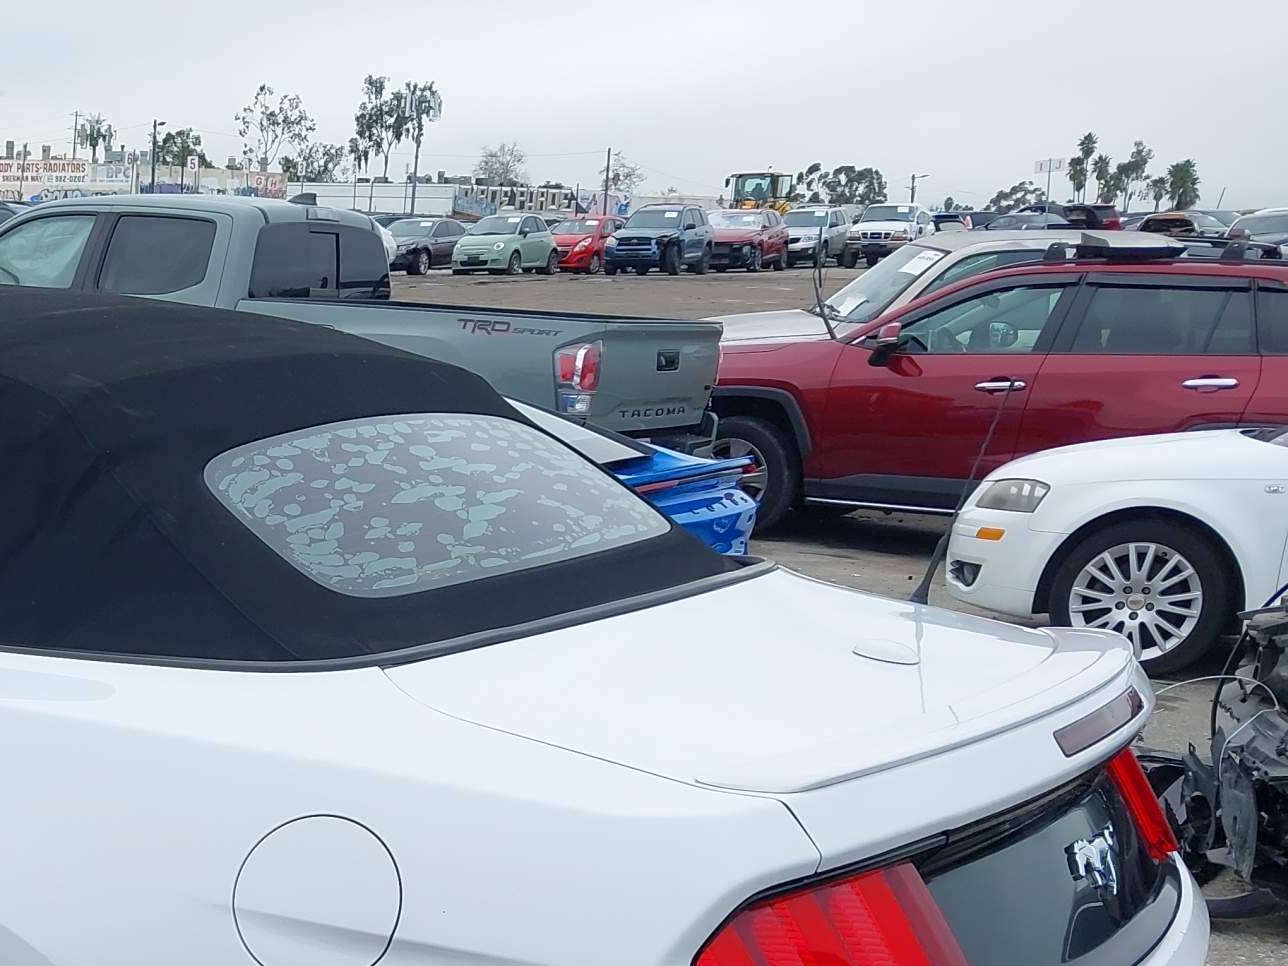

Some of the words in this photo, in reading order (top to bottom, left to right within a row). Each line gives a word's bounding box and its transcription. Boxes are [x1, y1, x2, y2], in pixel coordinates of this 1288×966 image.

[127, 153, 133, 165] 6
[189, 158, 196, 170] 5
[16, 162, 87, 173] PARTS-RADIATORS
[298, 163, 305, 174] 3
[457, 318, 511, 336] TRD
[512, 327, 562, 337] SPORT
[618, 406, 686, 418] TACOMA
